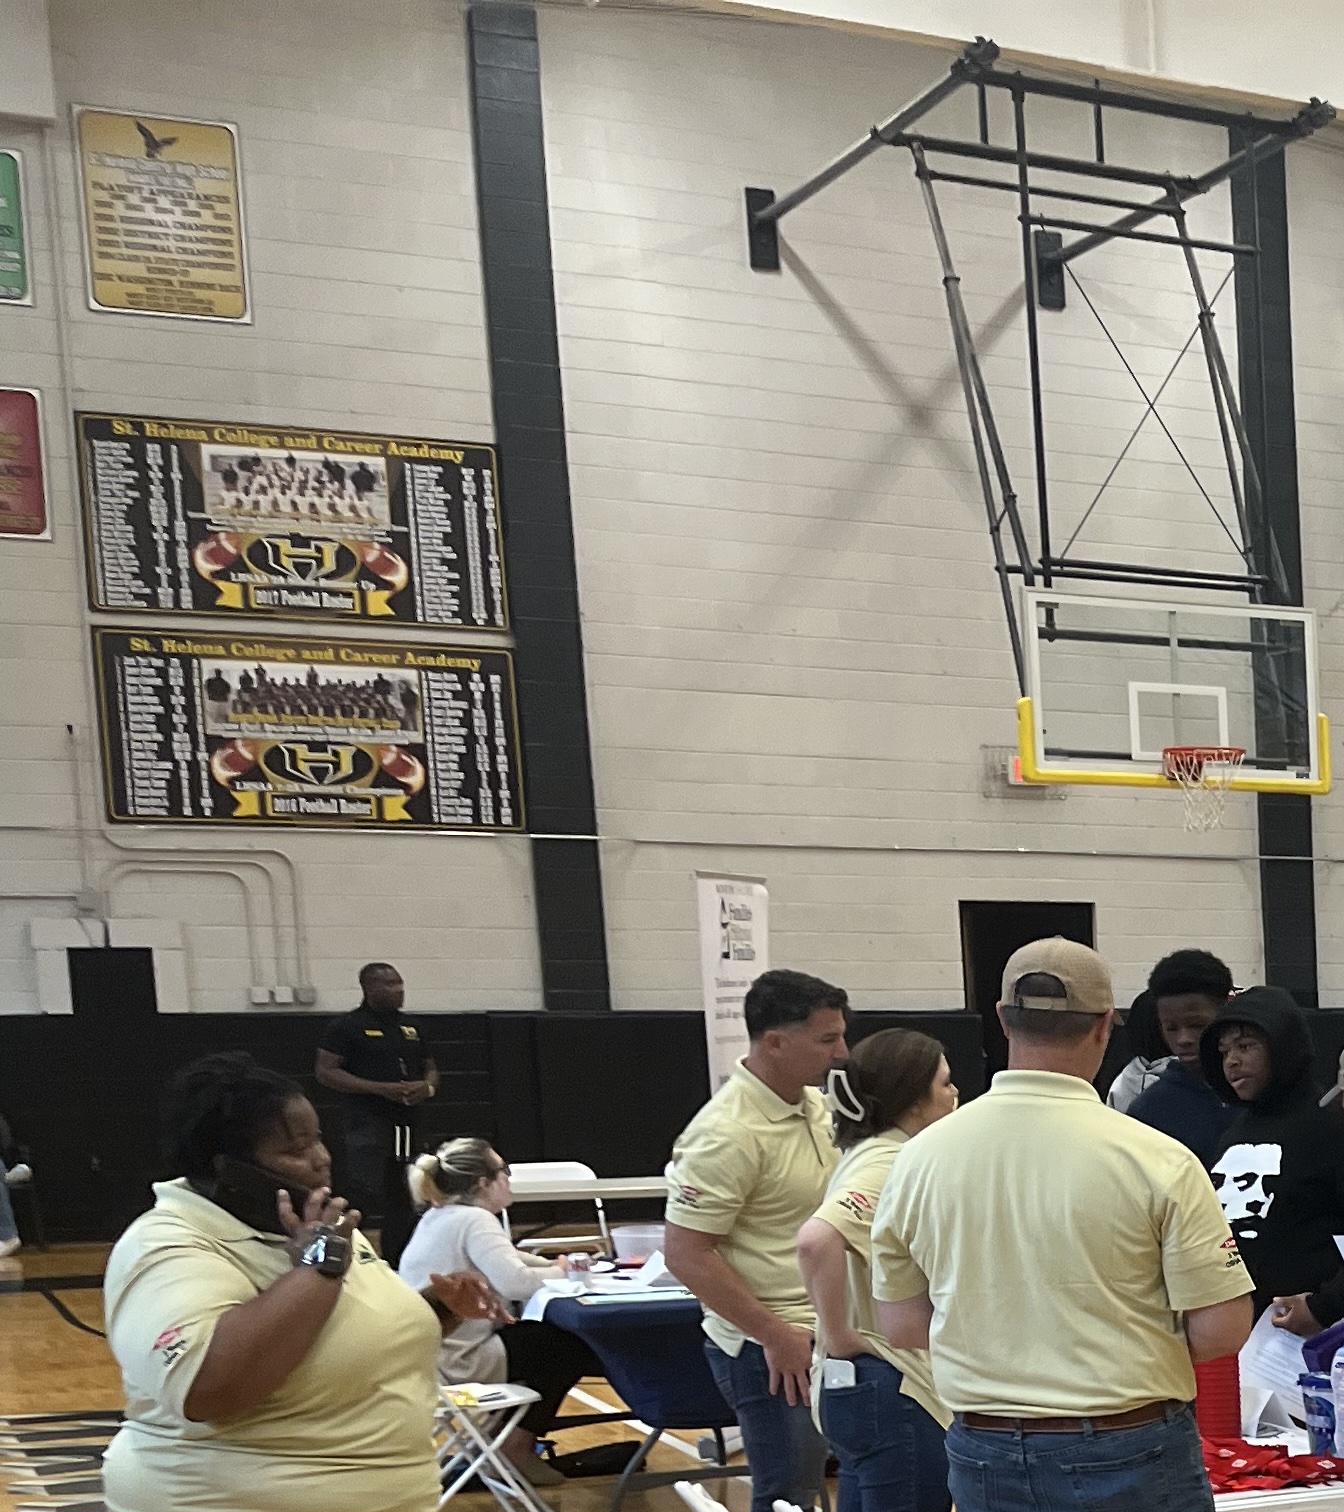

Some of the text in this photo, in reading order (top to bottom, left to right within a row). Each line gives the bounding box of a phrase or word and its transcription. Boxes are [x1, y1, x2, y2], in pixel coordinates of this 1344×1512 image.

[112, 419, 465, 464] St. Helena College and Career Academy
[130, 636, 481, 672] St. Helena College and Career Academy
